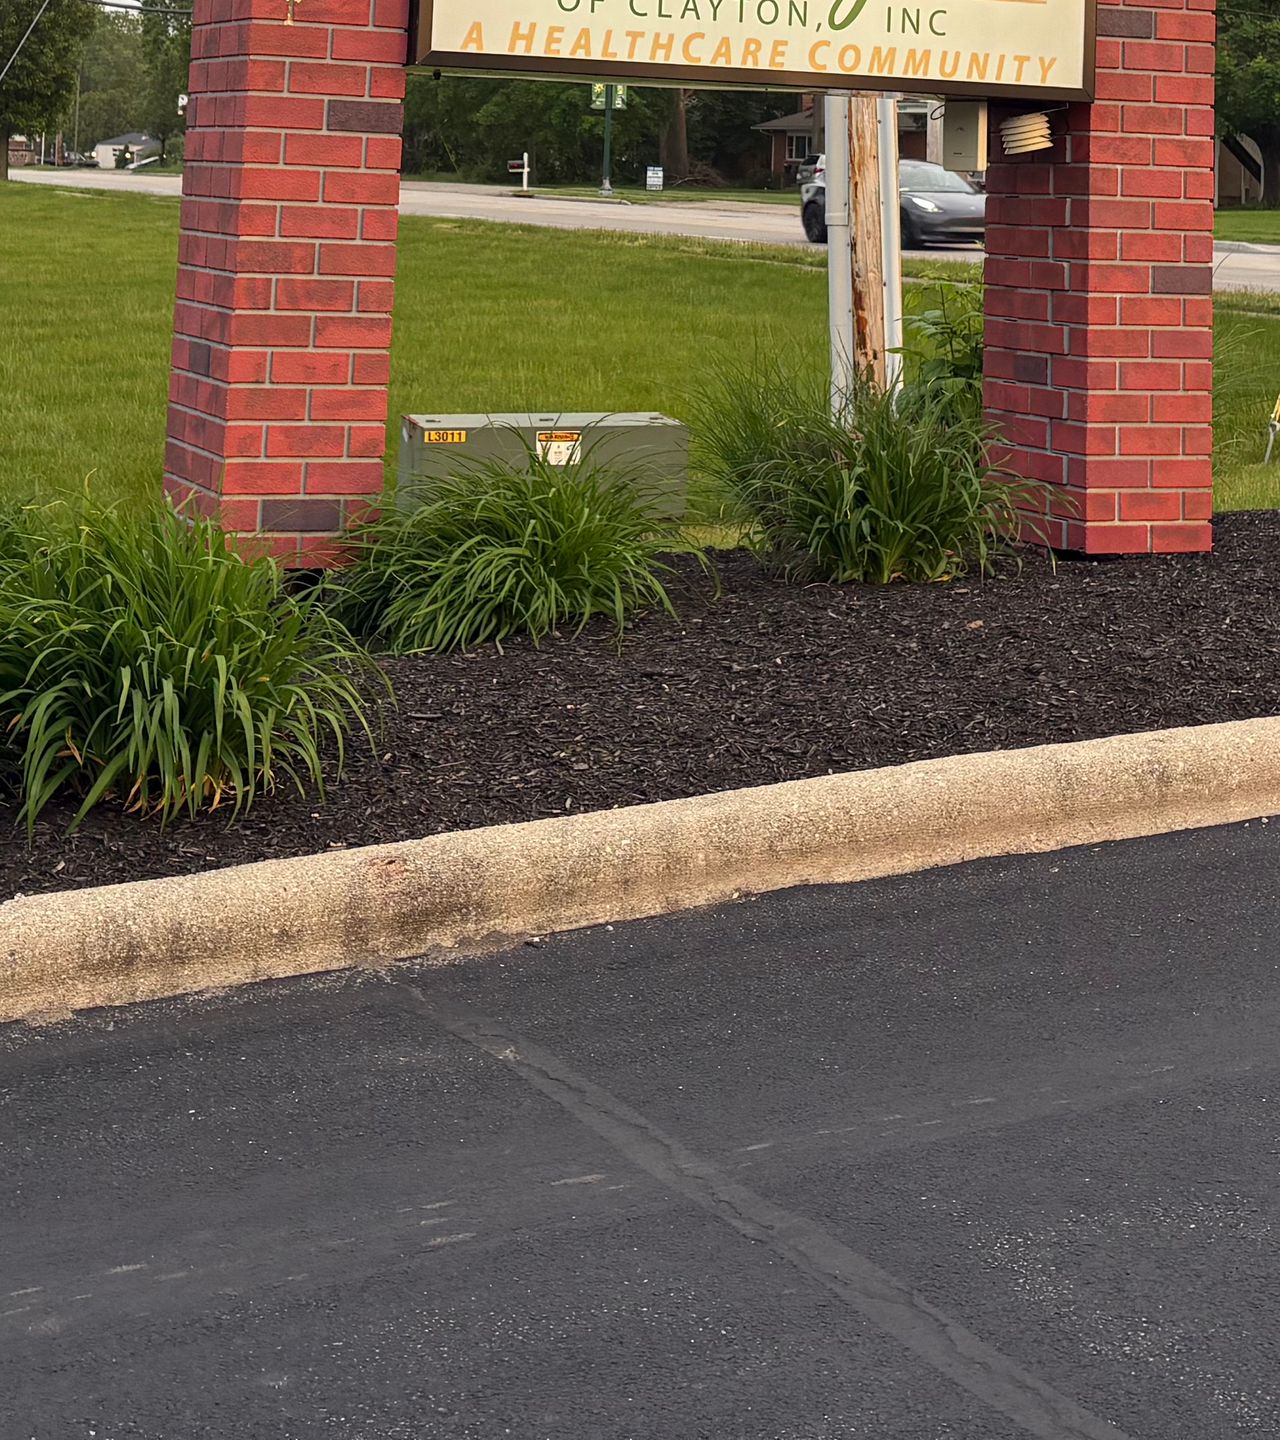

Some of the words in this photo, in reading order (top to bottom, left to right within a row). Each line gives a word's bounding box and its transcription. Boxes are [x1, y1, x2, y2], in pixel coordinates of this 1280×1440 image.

[885, 6, 948, 37] INC
[459, 21, 485, 52] A
[507, 21, 790, 69] HEALTHCARE
[807, 39, 1058, 85] COMMUNITY
[427, 431, 463, 442] L3011
